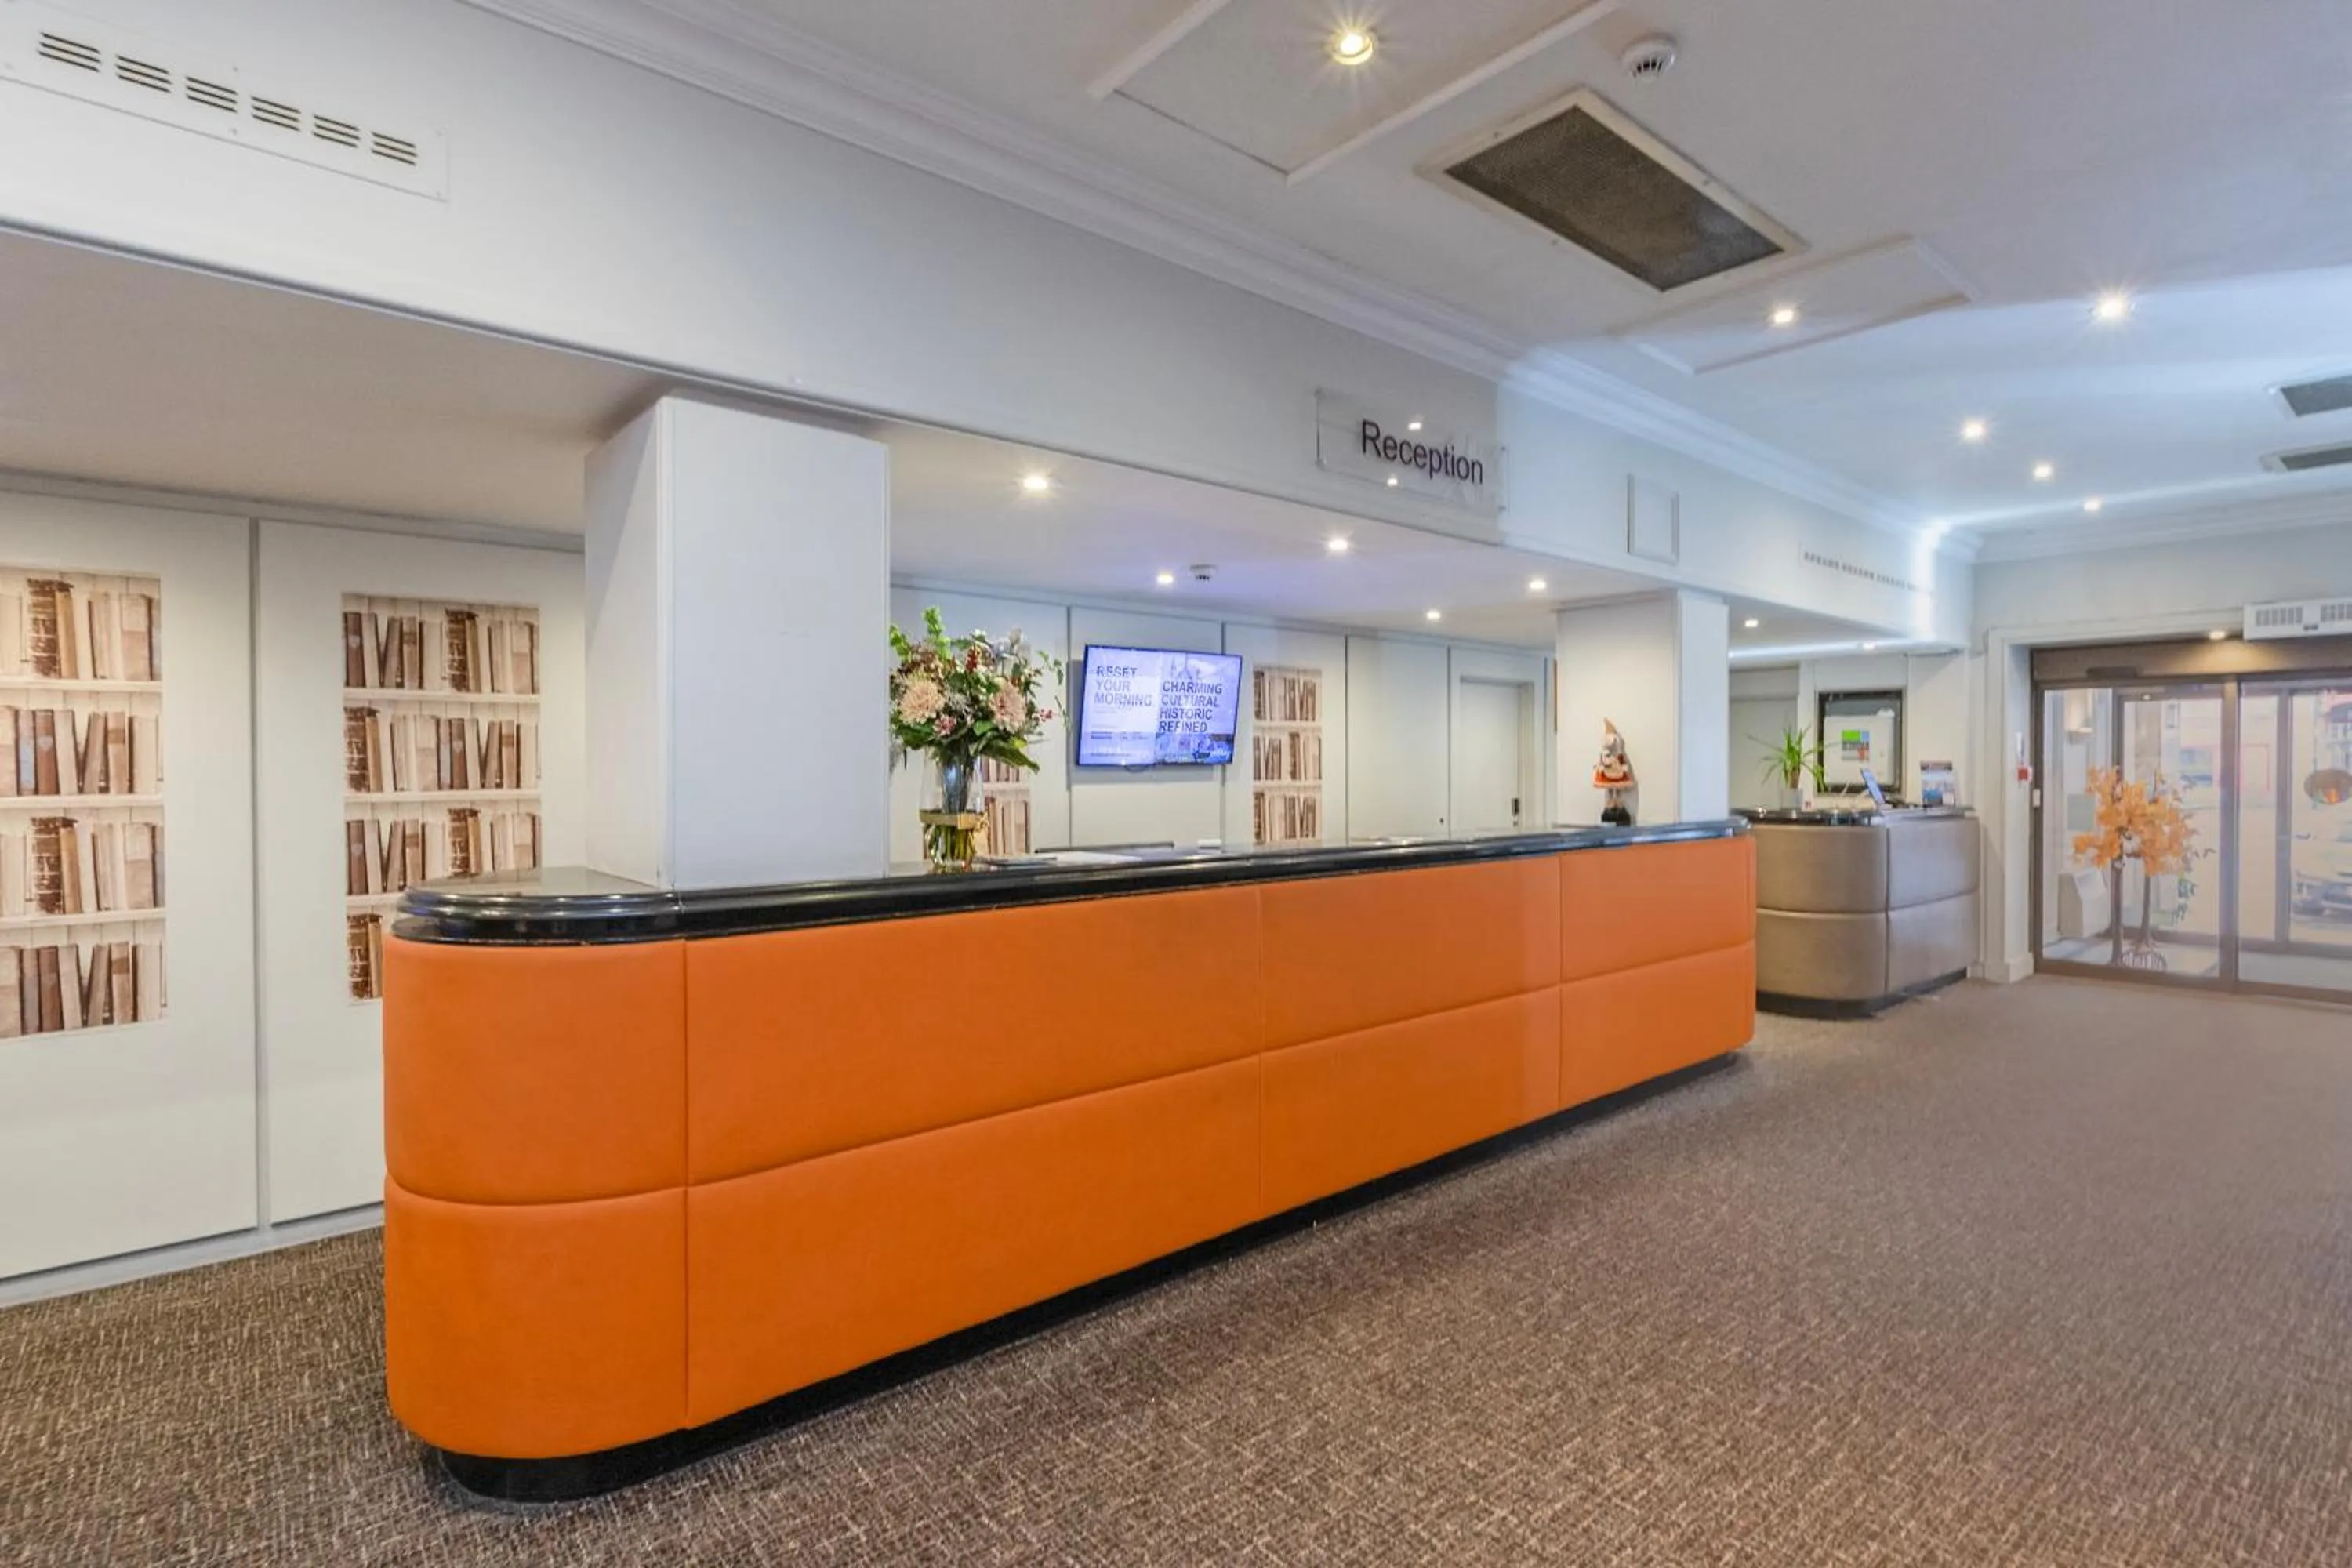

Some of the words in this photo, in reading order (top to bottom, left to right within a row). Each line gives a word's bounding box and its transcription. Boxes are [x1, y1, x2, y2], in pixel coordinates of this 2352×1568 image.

[1362, 419, 1483, 485] Reception
[1096, 665, 1138, 678] RESET
[1095, 679, 1131, 691] YOUR
[1162, 681, 1223, 695] CHARMING
[1094, 692, 1152, 706] MORNING
[1161, 694, 1220, 708] CULTURAL
[1160, 707, 1213, 720] HISTORIC
[1159, 720, 1208, 733] REFINED
